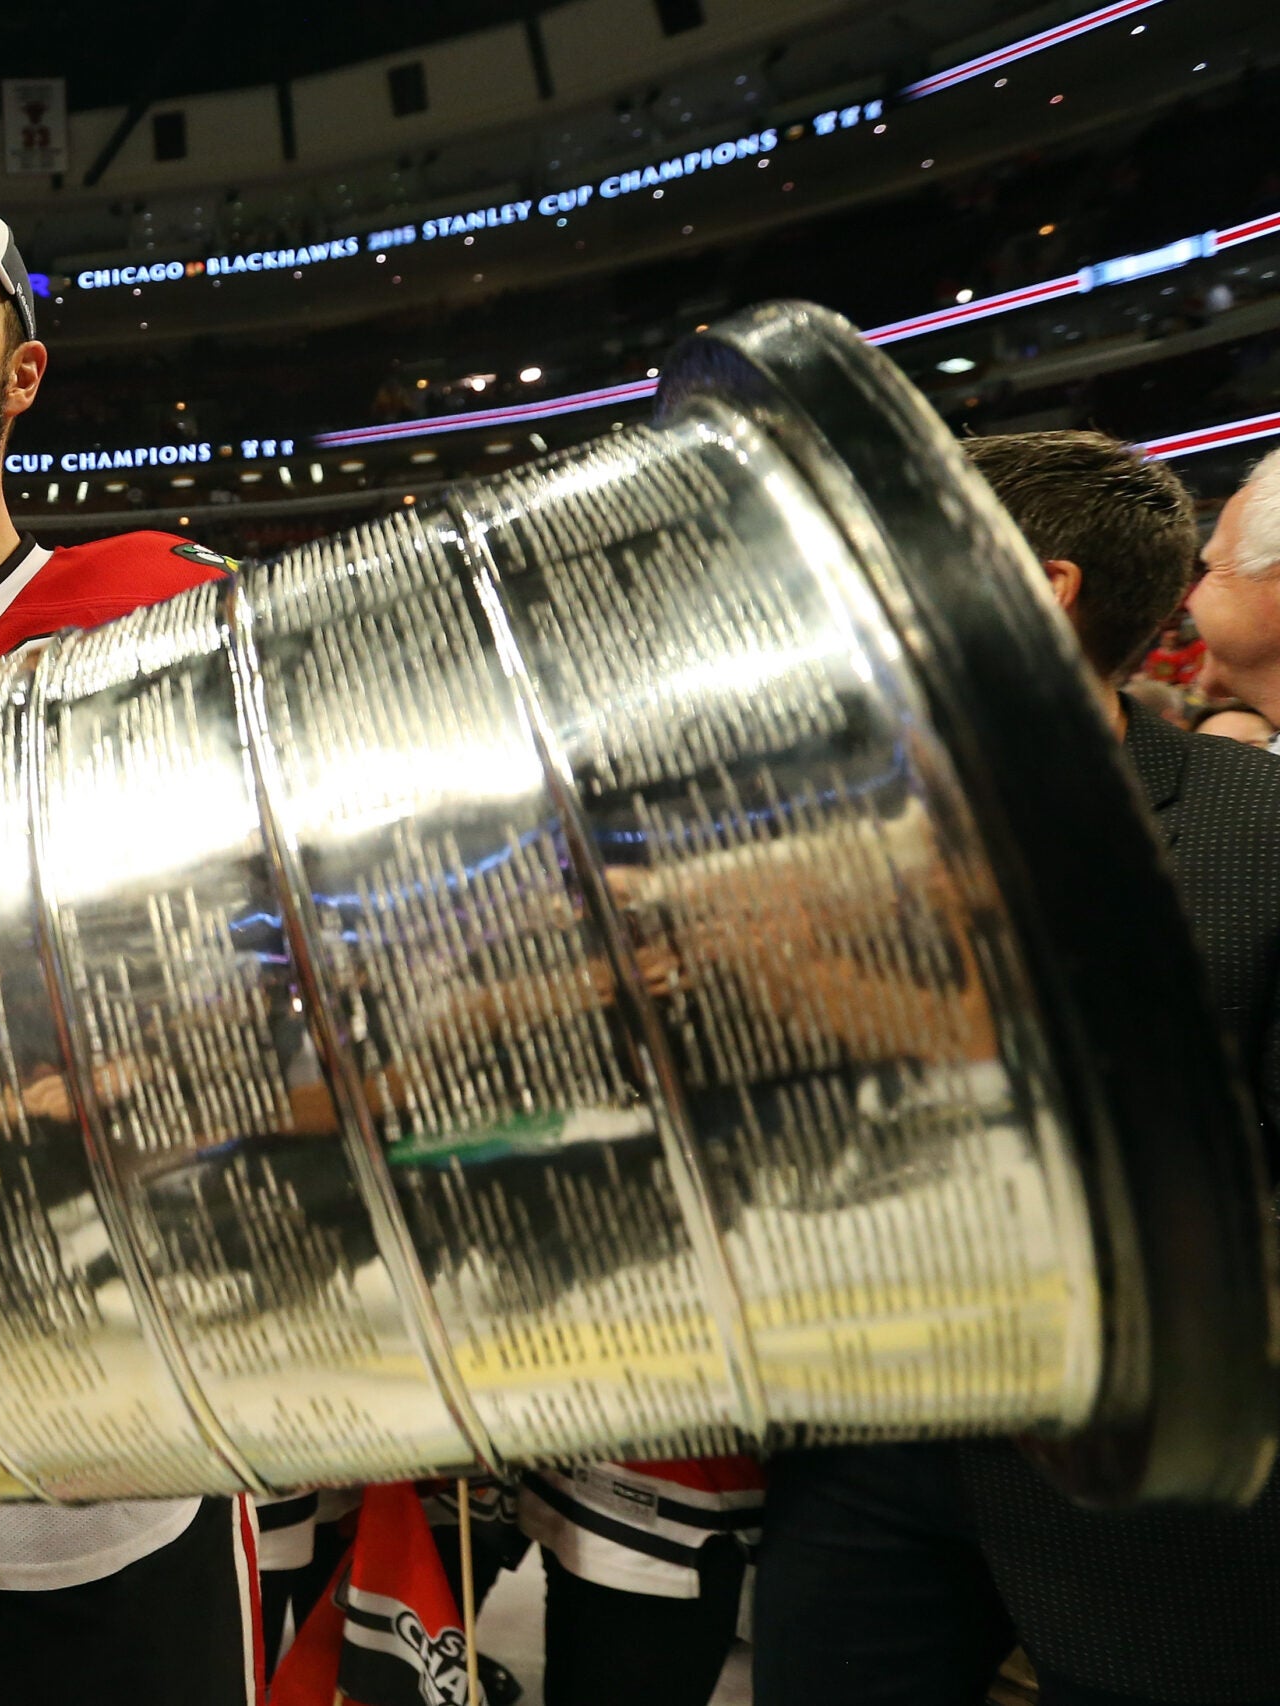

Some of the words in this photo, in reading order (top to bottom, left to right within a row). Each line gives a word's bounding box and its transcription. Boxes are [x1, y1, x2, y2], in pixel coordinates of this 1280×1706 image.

[77, 262, 184, 290] CHICAGO
[206, 236, 359, 276] BLACKHAWKS
[422, 200, 533, 241] STANLEY
[538, 184, 594, 216] CUP
[599, 128, 778, 199] CHAMPIONS
[4, 453, 54, 473] CUP
[60, 442, 212, 473] CHAMPIONS
